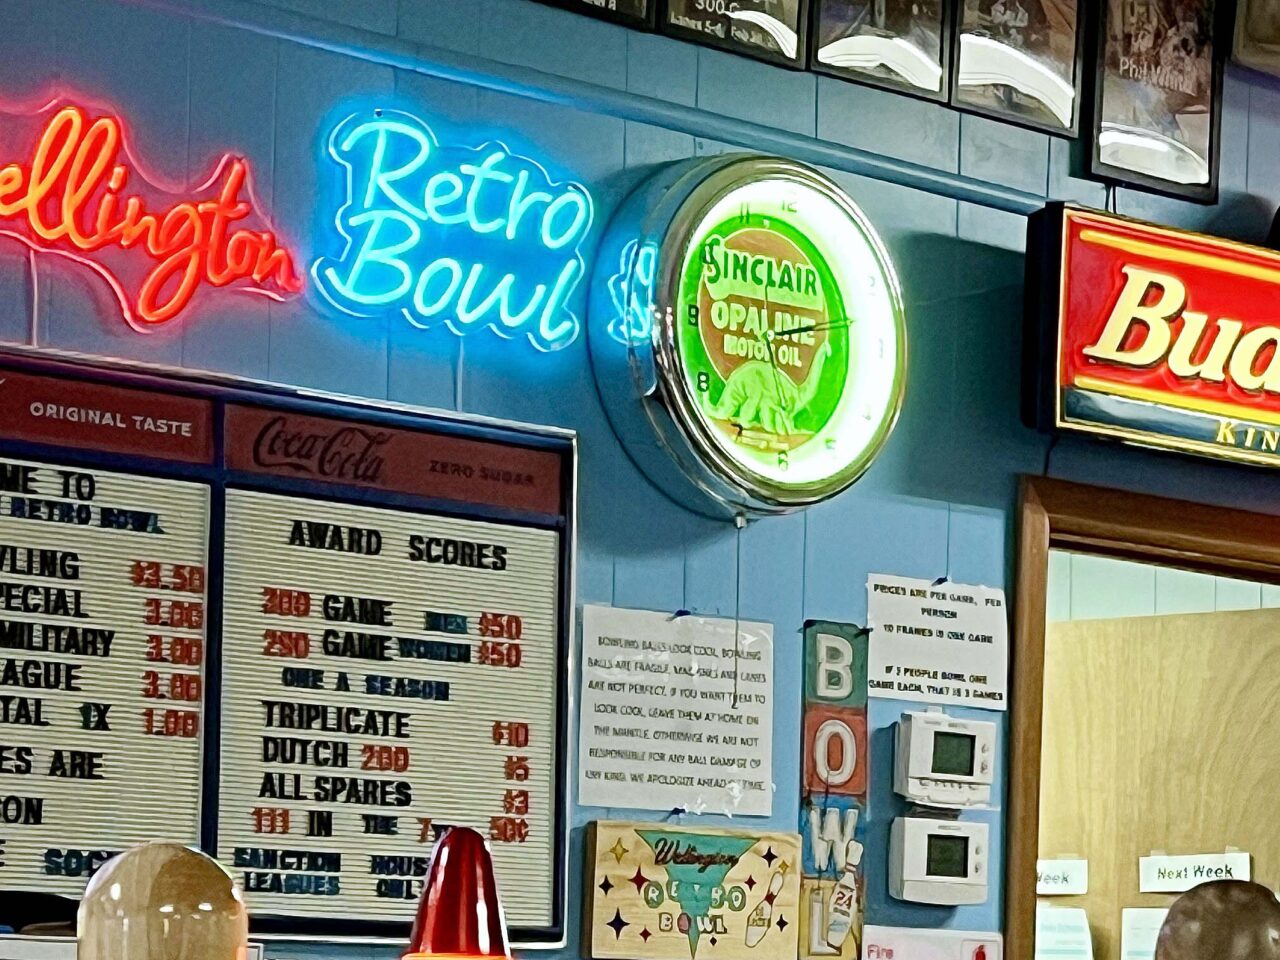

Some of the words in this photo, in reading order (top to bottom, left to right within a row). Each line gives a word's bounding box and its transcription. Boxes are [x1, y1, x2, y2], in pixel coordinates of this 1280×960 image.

[343, 119, 588, 250] Retro
[325, 211, 578, 341] Bowl
[705, 235, 818, 297] SINCLAIR
[778, 344, 803, 367] OIL
[29, 402, 126, 428] ORIGINAL
[132, 415, 193, 437] TASTE
[59, 470, 96, 501] TO
[429, 459, 474, 479] ZERO
[288, 519, 383, 556] AWARD
[408, 534, 508, 571] SCORES
[322, 594, 394, 627] GAME
[322, 629, 394, 662] GAME
[259, 700, 413, 739] TRIPLICATE
[50, 750, 105, 780] ARE
[262, 735, 350, 768] DUTCH
[360, 744, 410, 773] 200
[258, 771, 307, 801] ALL
[314, 776, 413, 807] SPARES
[307, 810, 333, 838] IN
[1157, 866, 1188, 880] Next
[1193, 864, 1234, 879] Week
[867, 944, 894, 960] Fire
